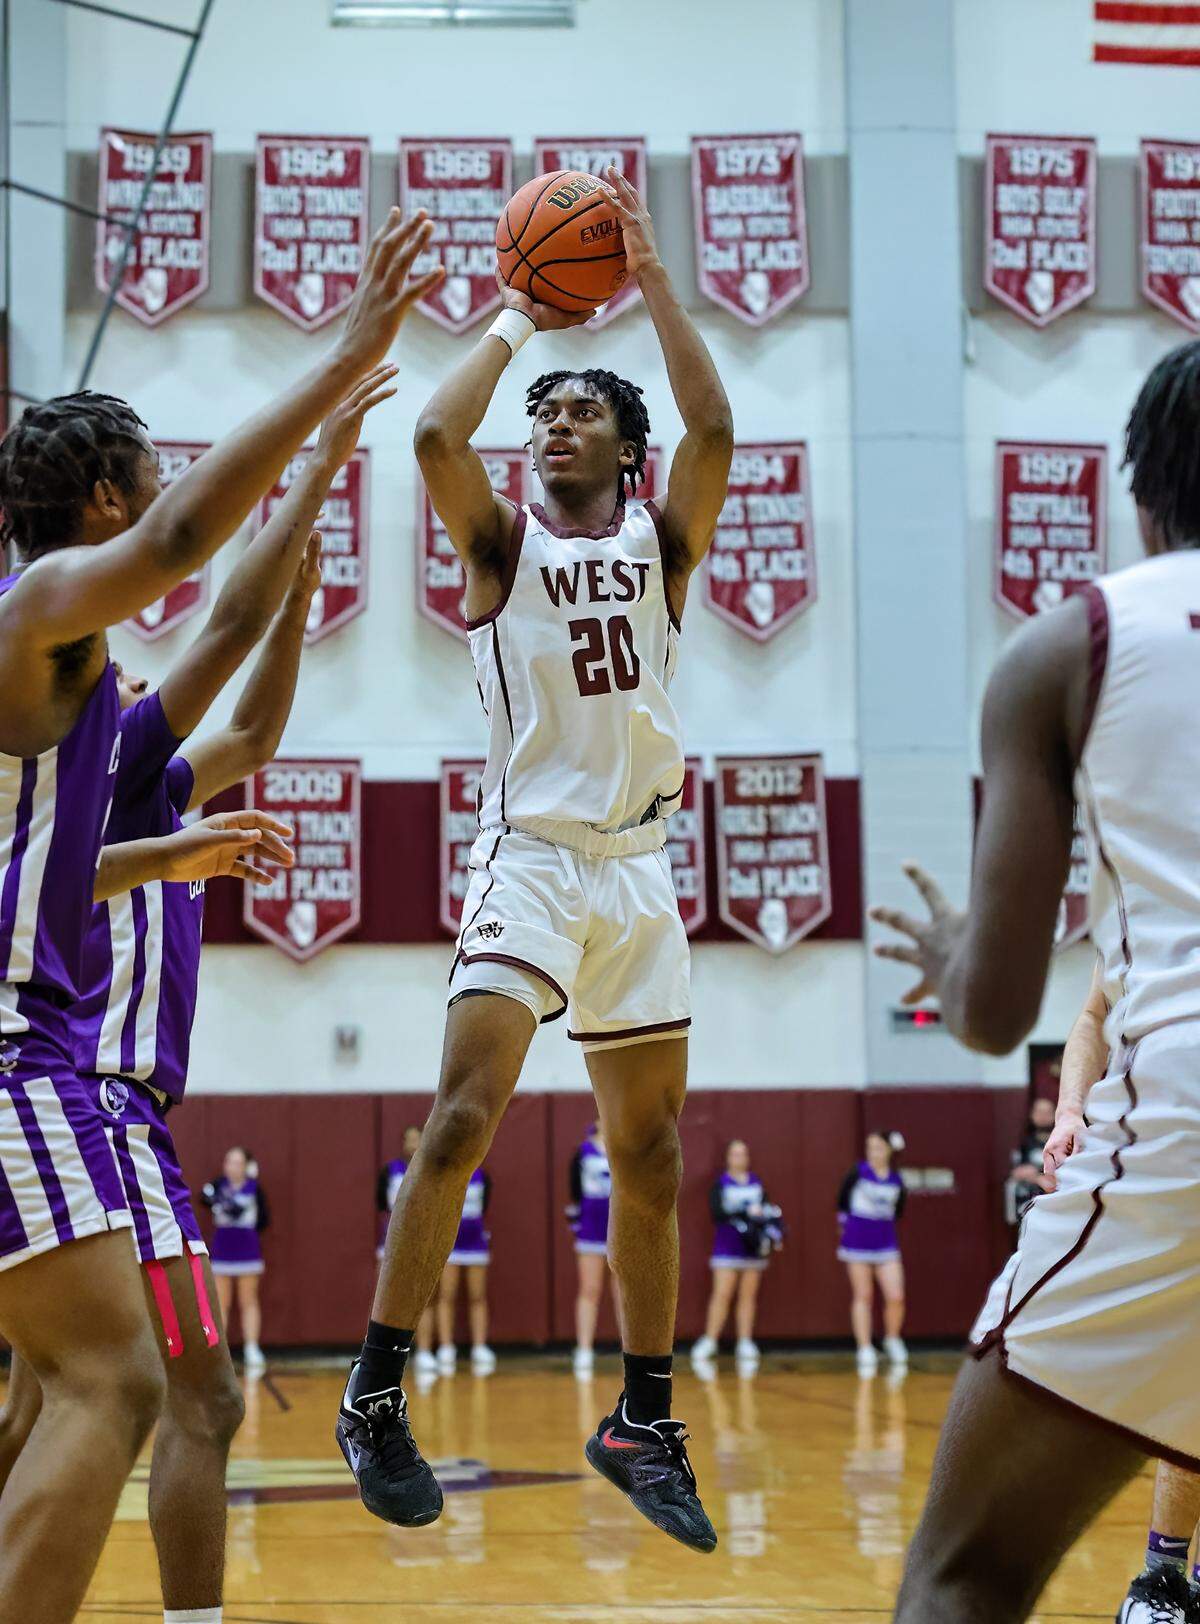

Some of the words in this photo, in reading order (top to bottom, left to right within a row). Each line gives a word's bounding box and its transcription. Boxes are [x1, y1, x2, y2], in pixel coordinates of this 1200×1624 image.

[280, 148, 345, 178] 1964
[424, 150, 491, 180] 1966
[715, 148, 781, 177] 1973
[1009, 149, 1074, 178] 1975
[141, 237, 201, 269] PLACE
[301, 241, 361, 273] PLACE
[444, 246, 498, 276] PLAC
[743, 239, 801, 270] PLACE
[1031, 240, 1088, 271] PLACE
[728, 454, 785, 487] 994
[1018, 453, 1085, 484] 1997
[745, 552, 806, 581] PLACE
[539, 559, 650, 608] WEST
[567, 615, 640, 697] 20
[264, 770, 343, 802] 2009
[736, 767, 803, 797] 2012
[291, 869, 352, 900] PLACE
[762, 865, 821, 897] PLACE
